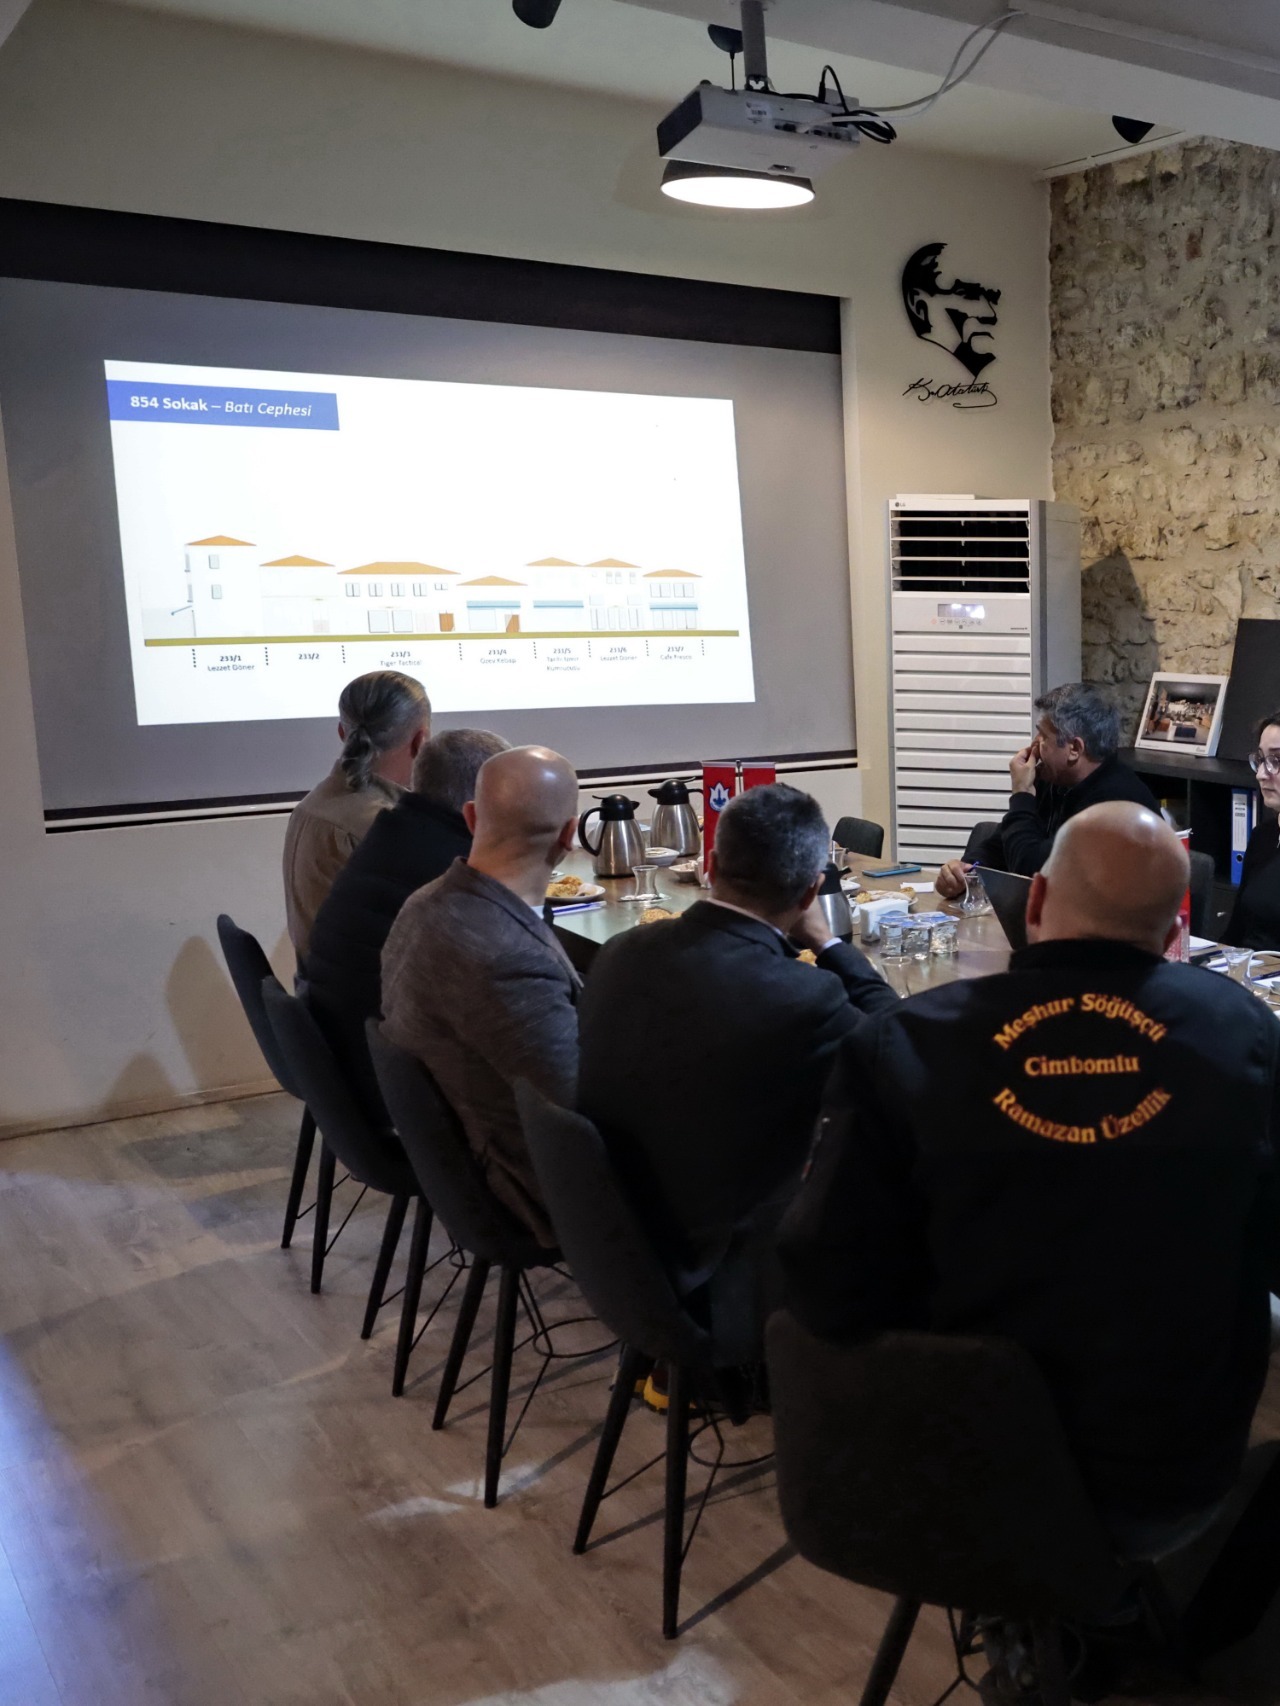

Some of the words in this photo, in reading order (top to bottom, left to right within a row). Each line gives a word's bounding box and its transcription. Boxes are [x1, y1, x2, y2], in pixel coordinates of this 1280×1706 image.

[130, 396, 159, 409] 854
[163, 397, 208, 411] Sokak
[225, 401, 253, 414] Batı
[257, 402, 312, 417] Cephesi
[207, 664, 231, 672] Lezzet
[993, 997, 1075, 1050] Meşhur
[1080, 993, 1168, 1043] Söğüşçü
[1023, 1054, 1140, 1076] Cimbomlu
[993, 1087, 1097, 1144] Ramazan
